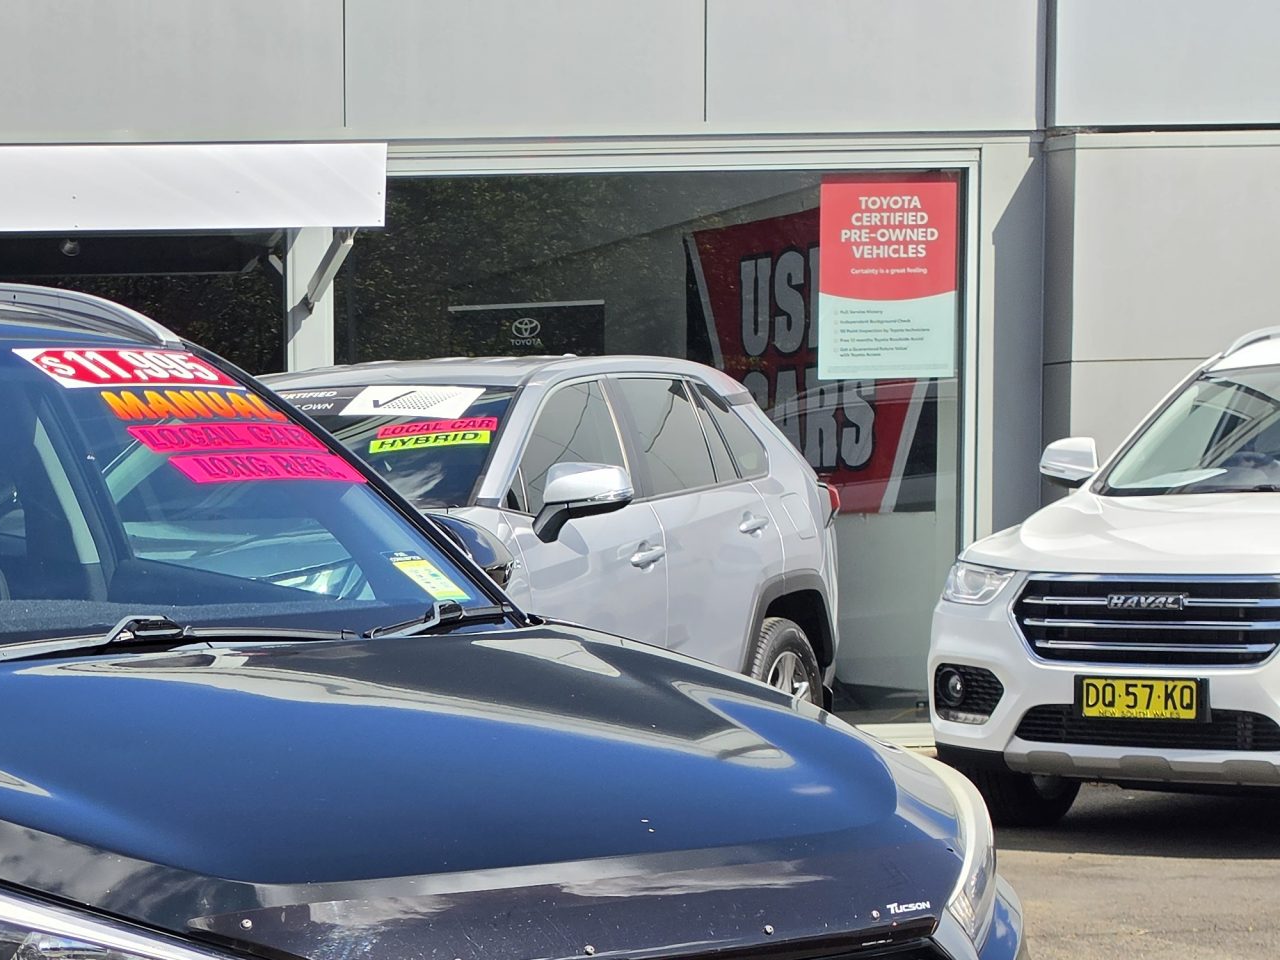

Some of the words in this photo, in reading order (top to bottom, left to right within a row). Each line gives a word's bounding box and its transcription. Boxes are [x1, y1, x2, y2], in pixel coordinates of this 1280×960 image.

[859, 196, 922, 210] TOYOTA
[851, 212, 929, 226] CERTIFIED
[841, 228, 939, 243] PRE-OWNED
[852, 244, 927, 259] VEHICLES
[740, 246, 819, 356] US
[510, 338, 542, 346] TOYOTA
[280, 391, 337, 399] ERTIFIED
[100, 392, 289, 422] MANUAL
[301, 403, 334, 411] OWN
[380, 423, 443, 437] LOCAL
[450, 419, 491, 429] CAR
[139, 426, 252, 449] LOCAL
[246, 425, 321, 448] CAR
[377, 432, 480, 450] HYBRID
[192, 457, 281, 480] LONG
[1109, 595, 1180, 608] HAVAL
[1085, 682, 1116, 709] DQ
[1124, 683, 1155, 710] 57
[1163, 684, 1194, 711] KQ
